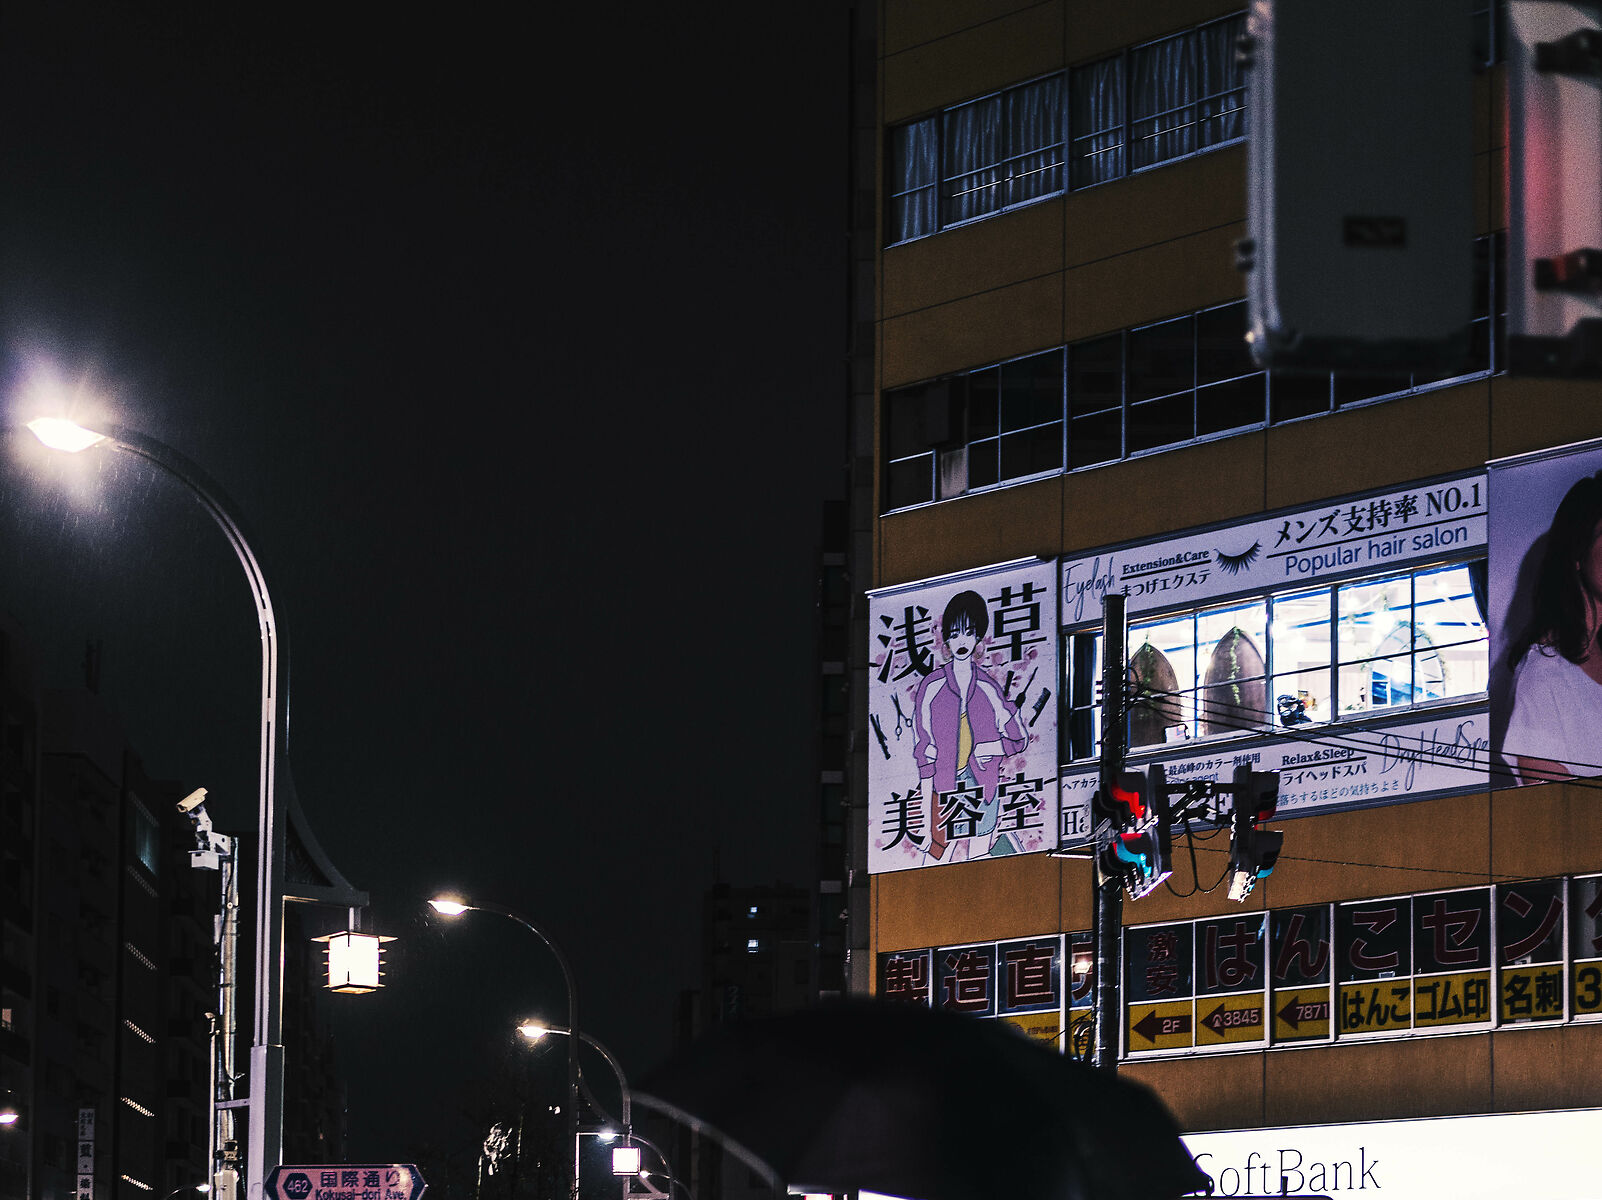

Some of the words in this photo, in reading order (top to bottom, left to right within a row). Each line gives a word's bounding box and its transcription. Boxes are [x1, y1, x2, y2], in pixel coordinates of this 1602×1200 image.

[1273, 494, 1419, 549] メンズ支持率
[1425, 482, 1483, 517] NO.1
[1122, 549, 1210, 576] Extension&Care
[1285, 546, 1363, 576] Popular
[1368, 536, 1407, 561] hair
[1412, 525, 1468, 551] salon
[1063, 556, 1115, 622] Eyelash
[1120, 569, 1212, 597] まつげエクステ
[1163, 752, 1261, 776] 最高峰のカラー剤使用
[1281, 748, 1355, 766] Relax&Sleep
[1062, 777, 1100, 791] ヘアカラ
[1281, 761, 1368, 786] ライヘッドスパ
[882, 772, 1045, 852] 美容室
[1205, 890, 1601, 991] はんこセン
[1162, 1018, 1181, 1033] 2F
[1223, 1008, 1260, 1026] 3845
[1295, 1003, 1329, 1020] 7871
[287, 1179, 309, 1194] 462
[320, 1171, 400, 1188] 国際通り
[1193, 1146, 1381, 1198] SoftBank
